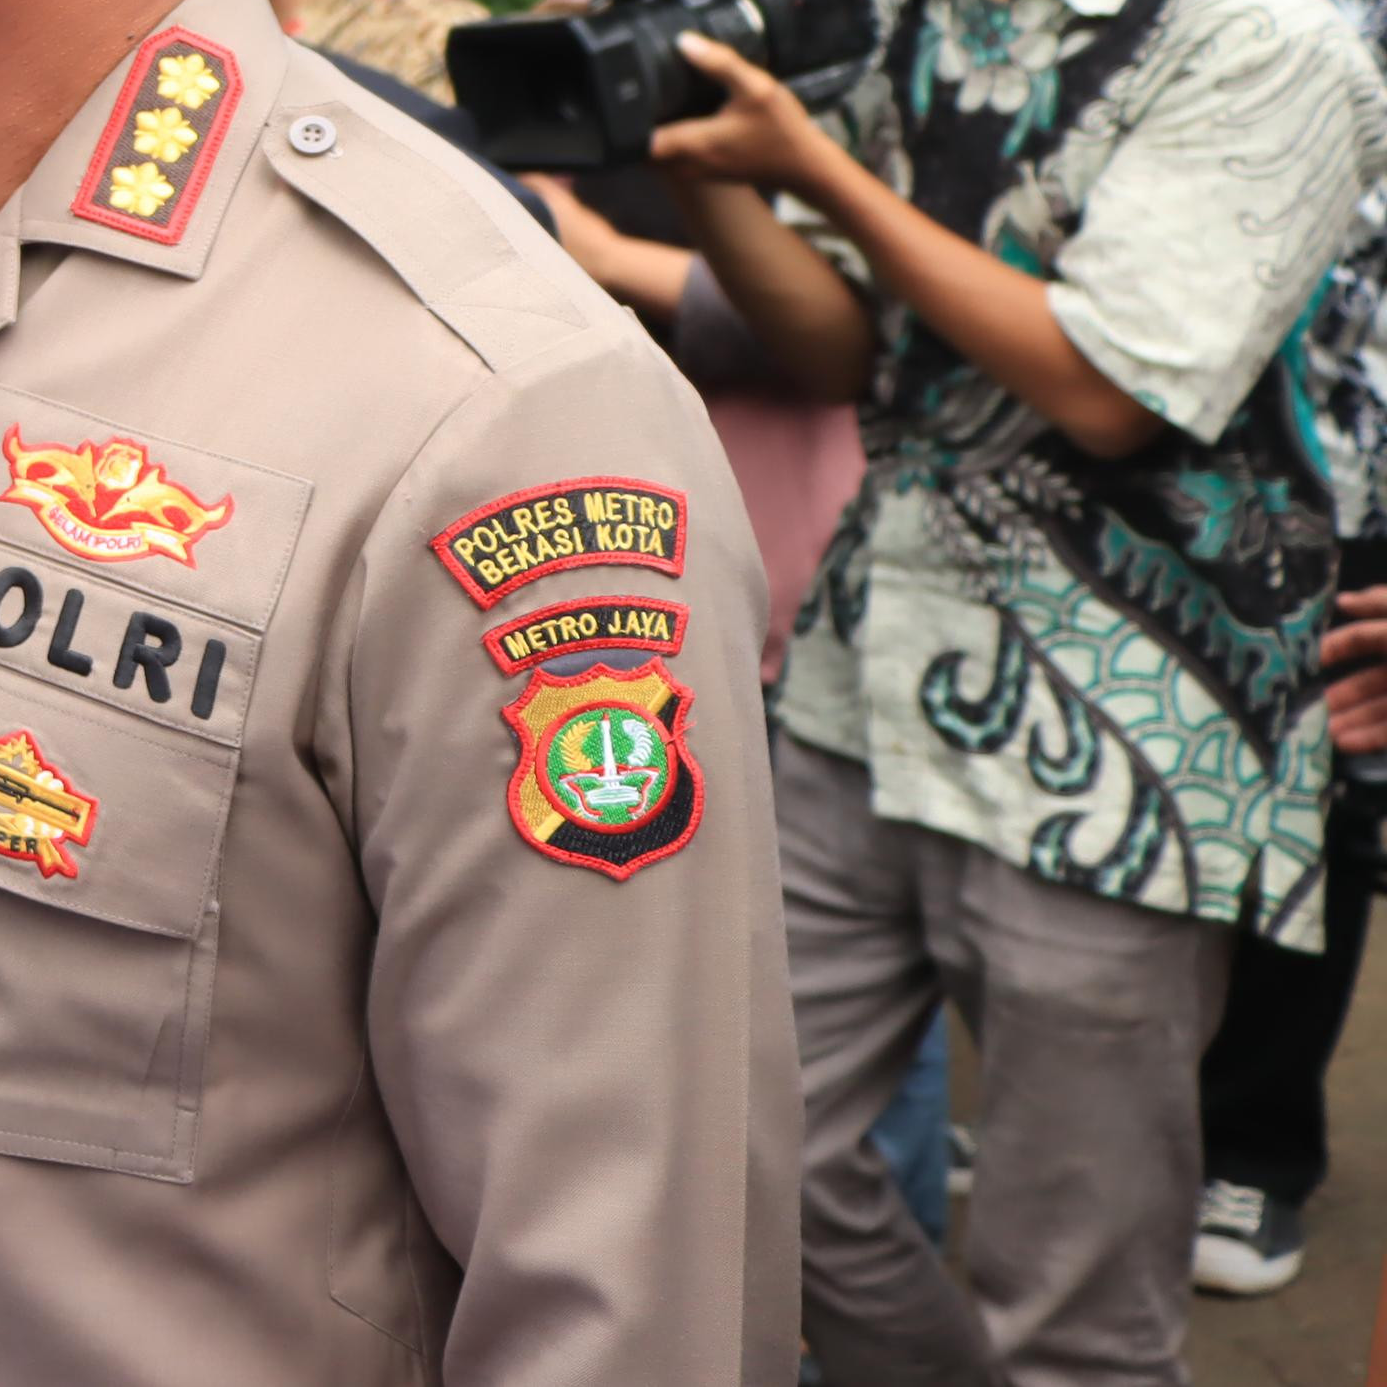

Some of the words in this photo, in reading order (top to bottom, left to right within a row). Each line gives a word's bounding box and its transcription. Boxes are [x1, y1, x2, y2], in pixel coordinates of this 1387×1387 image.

[453, 497, 576, 565] POLRES
[583, 492, 675, 530] METRO
[477, 526, 585, 585] BEKASI
[596, 524, 665, 557] KOTA
[504, 612, 598, 659] METRO
[607, 611, 670, 640] JAYA
